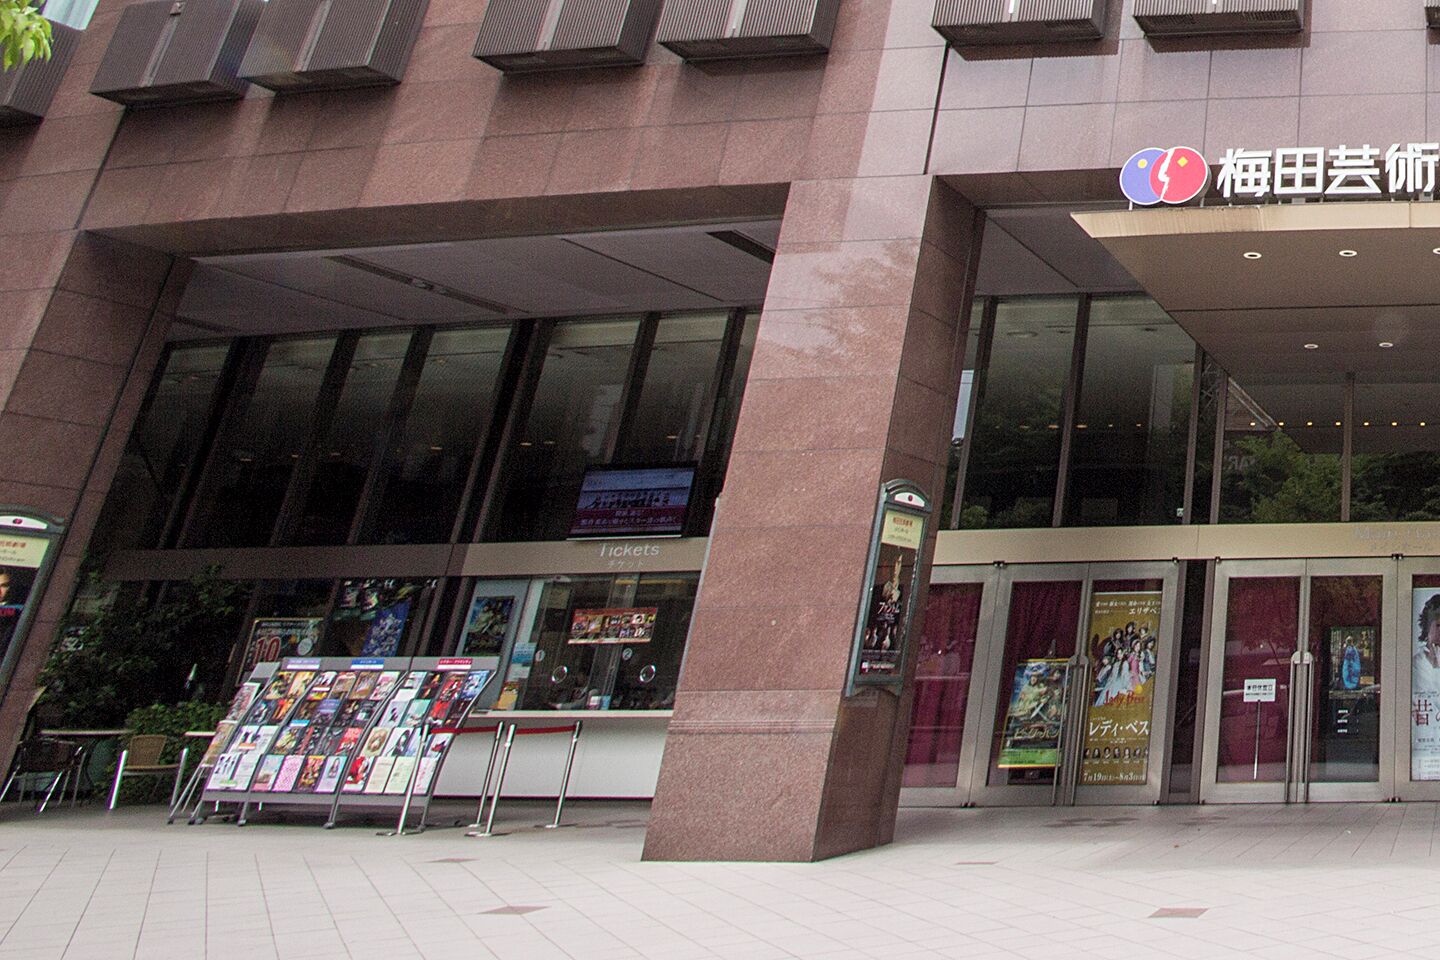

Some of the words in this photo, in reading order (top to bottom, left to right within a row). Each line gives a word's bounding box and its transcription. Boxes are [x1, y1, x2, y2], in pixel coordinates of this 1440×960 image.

[600, 543, 661, 558] Tickets
[1089, 720, 1150, 737] レディ・ベス
